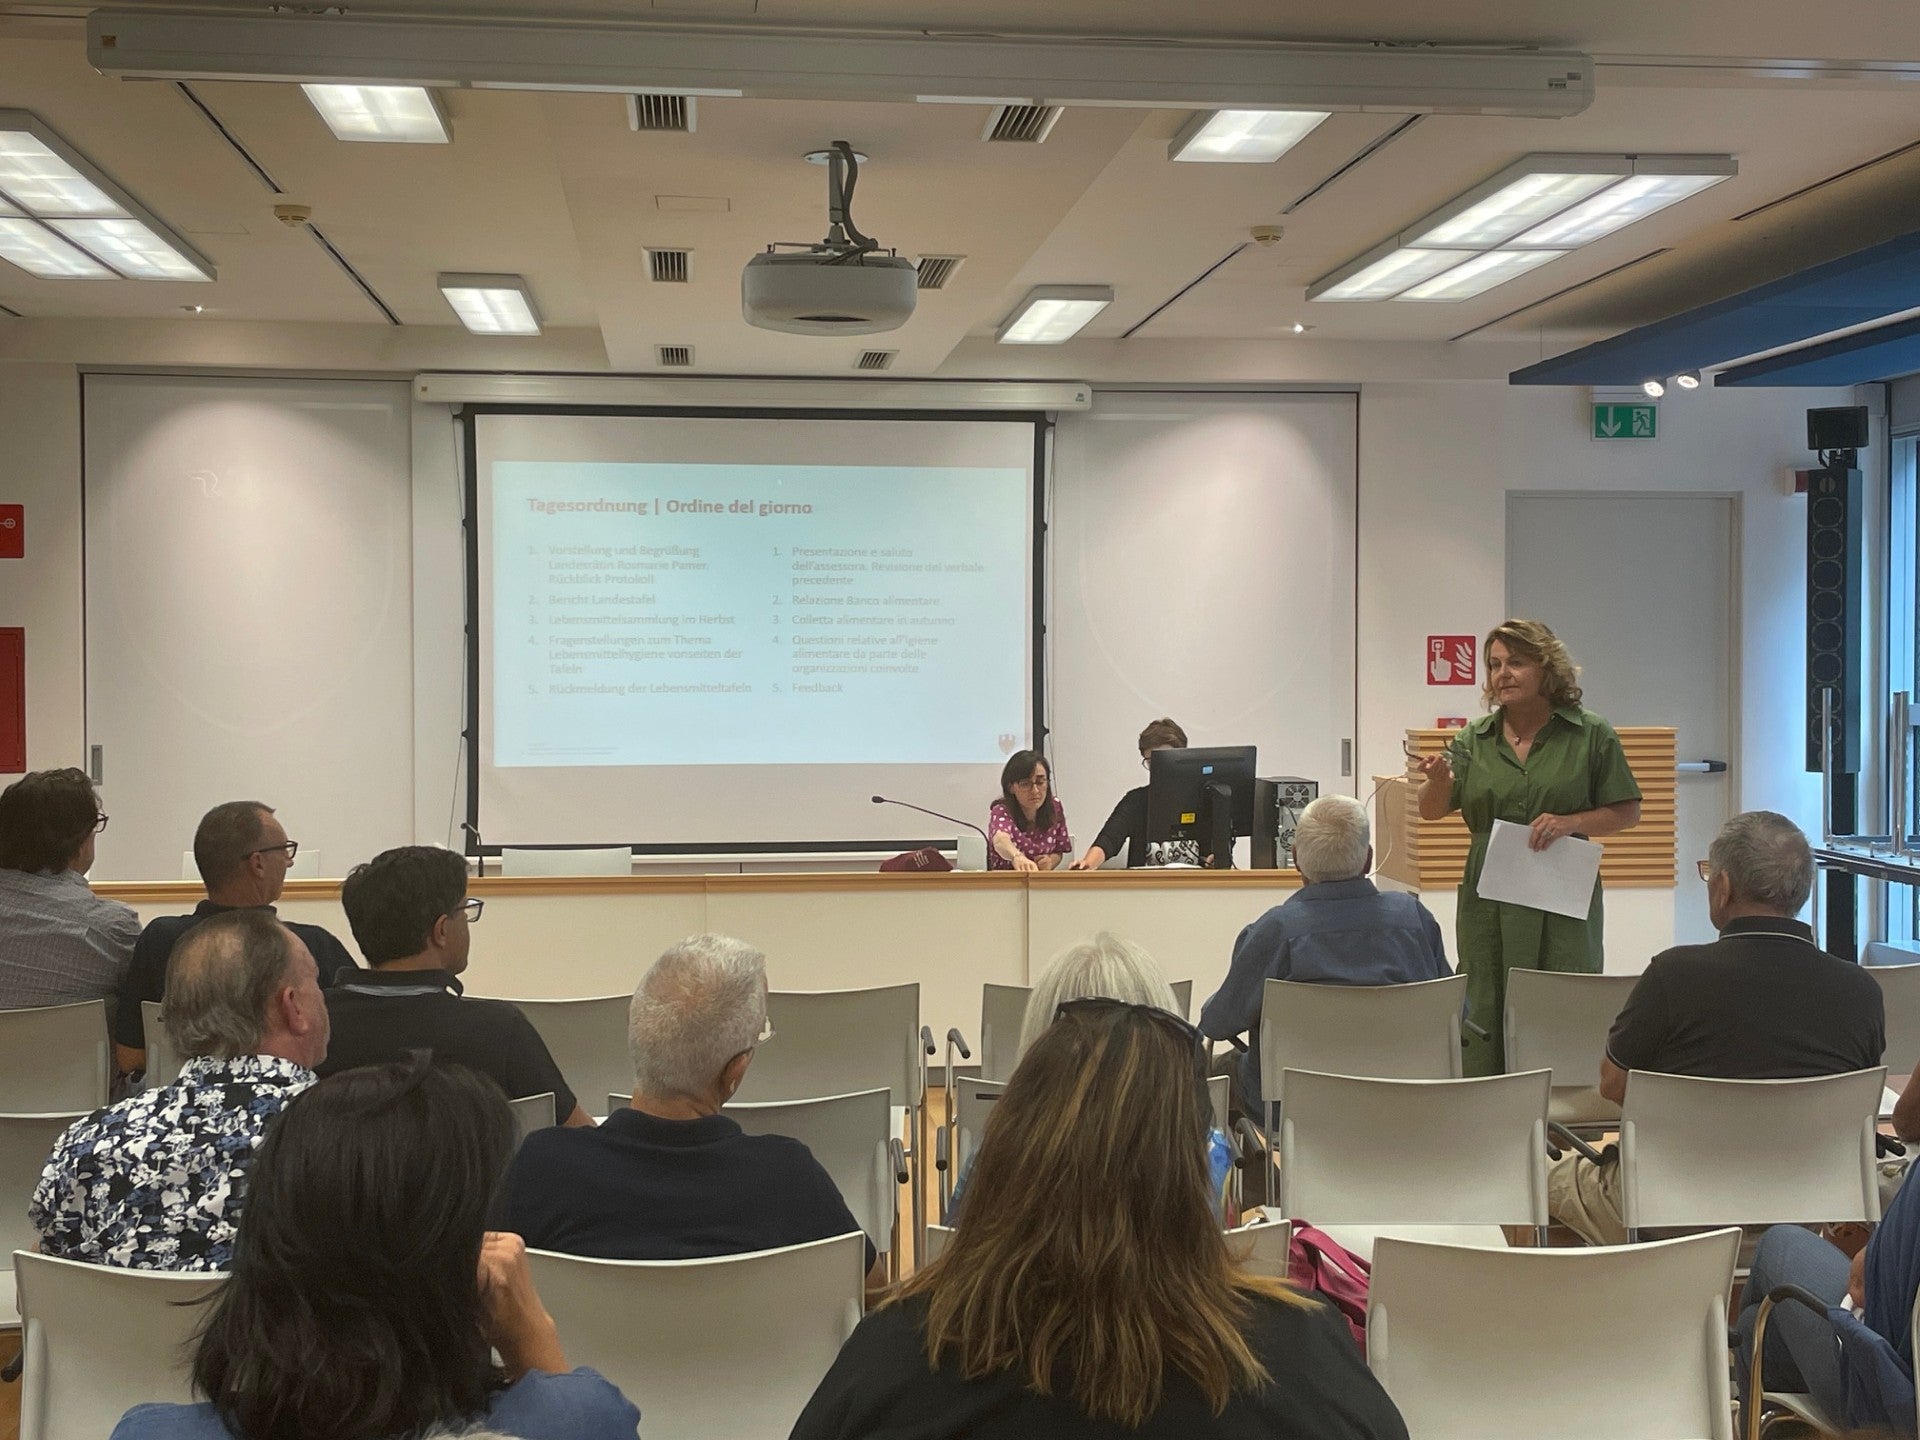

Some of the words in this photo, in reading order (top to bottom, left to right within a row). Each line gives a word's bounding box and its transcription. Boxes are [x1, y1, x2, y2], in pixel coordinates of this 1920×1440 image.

[527, 498, 648, 515] Tagesordnung
[666, 499, 724, 513] Ordine
[728, 499, 754, 513] del
[759, 501, 813, 516] giorno
[548, 545, 612, 558] Vorstellung
[614, 545, 637, 556] und
[639, 545, 700, 558] Begrüßung
[792, 547, 866, 557] Presentazione
[870, 549, 877, 557] e
[880, 547, 913, 557] saluto
[871, 562, 923, 572] Revisione
[925, 562, 942, 572] del
[944, 562, 984, 572] verbale
[549, 574, 602, 585] Rückblick
[605, 574, 654, 585] Protokoll
[792, 576, 854, 586] precedente
[549, 594, 588, 605] Bericht
[592, 594, 656, 605] Landestafel
[772, 595, 783, 605] 2.
[792, 595, 844, 605] Relazione
[847, 595, 879, 605] Banco
[882, 595, 940, 606] alimentare
[549, 614, 679, 626] Lebensmittelsammlung
[682, 615, 696, 625] im
[698, 615, 736, 625] Herbst
[792, 614, 833, 625] Colletta
[836, 614, 894, 625] alimentare
[897, 615, 906, 625] in
[909, 615, 955, 625] autunno
[549, 635, 645, 647] Fragenstellungen
[647, 637, 671, 645] zum
[673, 635, 711, 645] Thema
[792, 635, 844, 646] Questioni
[847, 635, 886, 646] relative
[549, 649, 666, 661] Lebensmittelhygiene
[667, 649, 721, 659] vonseiten
[724, 649, 742, 659] der
[792, 649, 849, 659] alimentare
[852, 649, 866, 659] da
[869, 650, 898, 661] parte
[901, 649, 927, 659] delle
[549, 664, 582, 674] Tafeln
[792, 664, 868, 675] organizzazioni
[870, 664, 919, 673] coinvolte
[549, 683, 625, 695] Rückmeldung
[628, 683, 647, 693] der
[650, 683, 752, 693] Lebensmitteltafeln
[772, 683, 783, 693] 5.
[792, 682, 843, 693] Feedback
